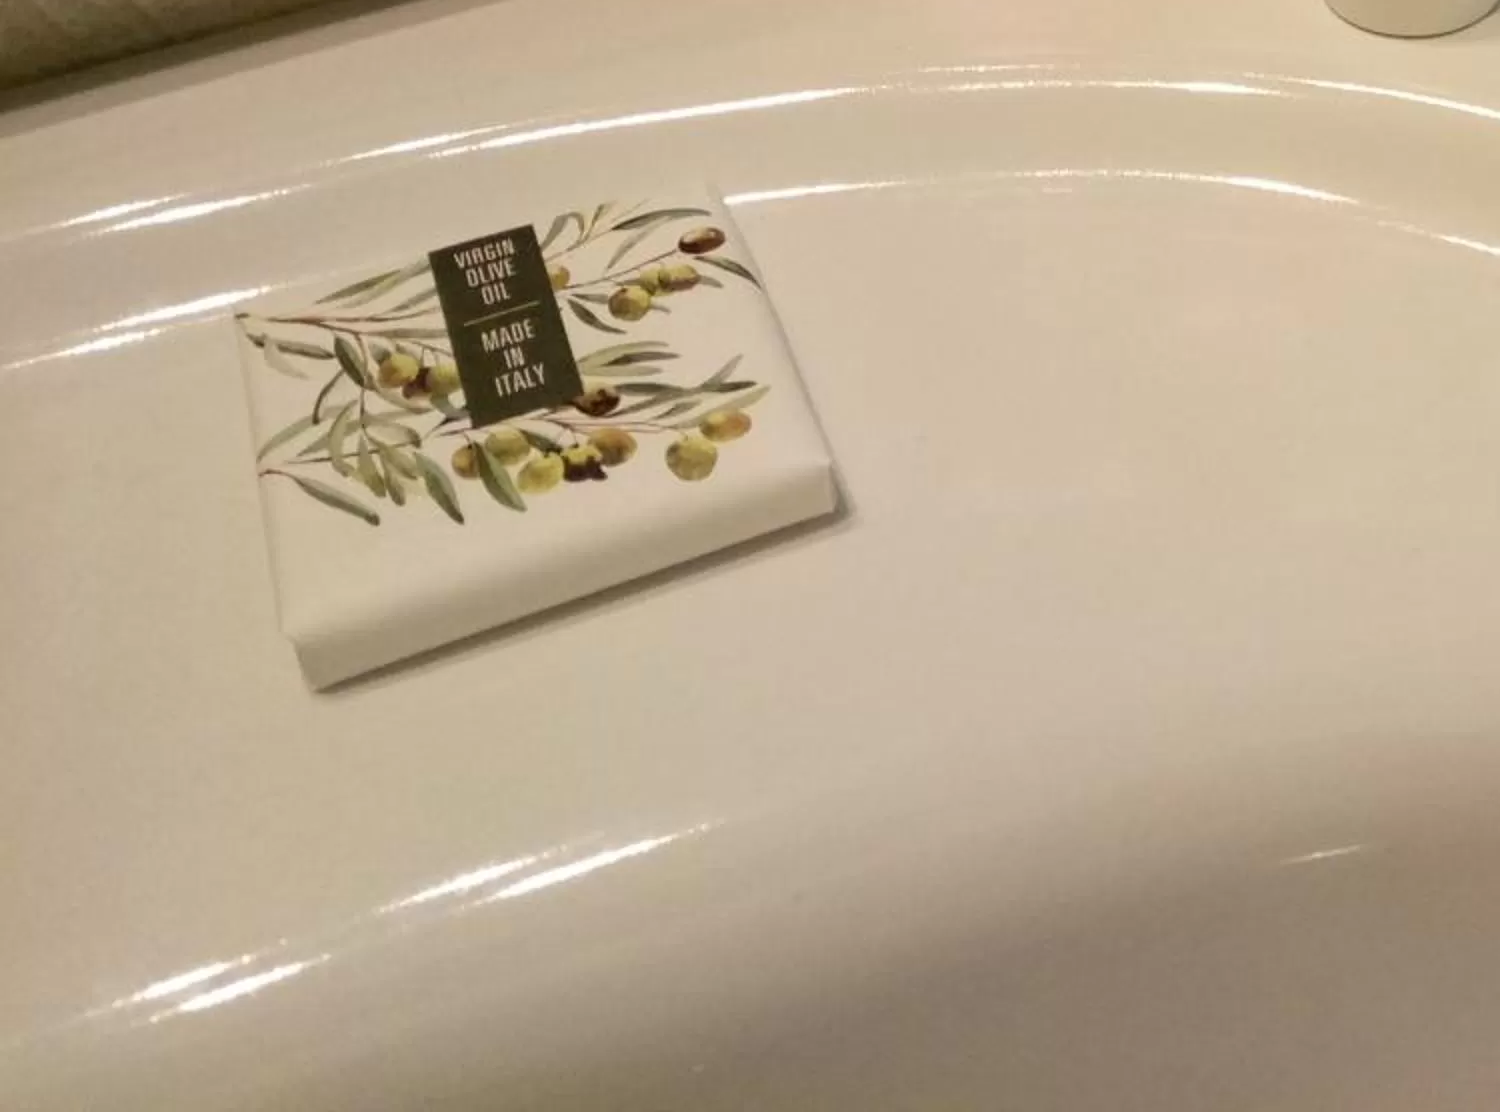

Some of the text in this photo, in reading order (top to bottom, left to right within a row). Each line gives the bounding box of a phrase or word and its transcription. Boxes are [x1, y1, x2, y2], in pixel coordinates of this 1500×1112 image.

[453, 237, 515, 269] VIRGIN
[465, 257, 516, 288] OLIVE
[481, 282, 511, 305] OIL
[481, 319, 535, 353] MADE
[503, 347, 525, 369] IN
[495, 363, 545, 397] ITALY
